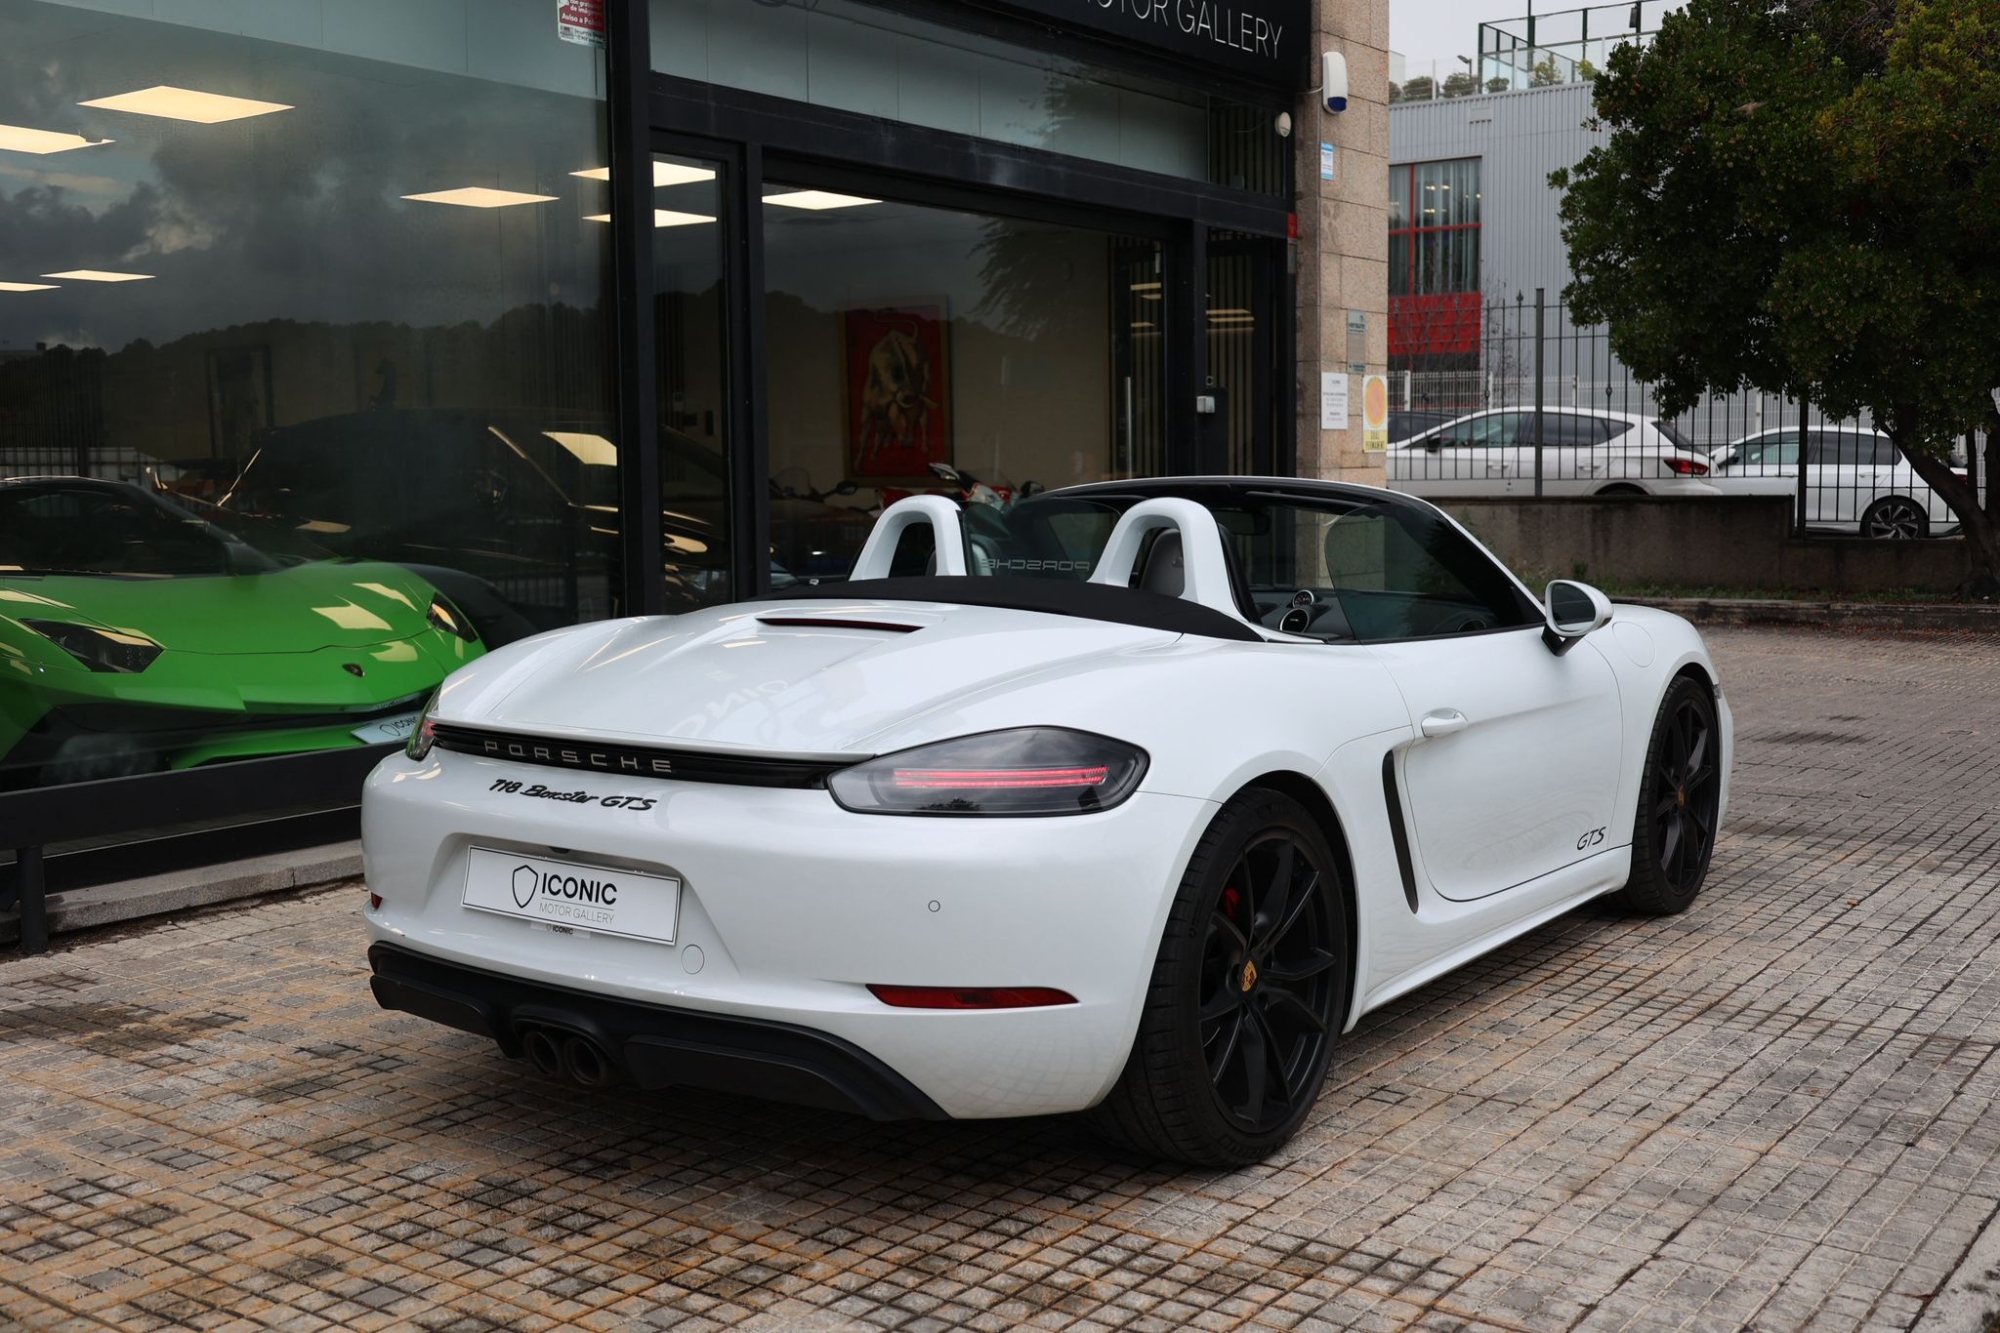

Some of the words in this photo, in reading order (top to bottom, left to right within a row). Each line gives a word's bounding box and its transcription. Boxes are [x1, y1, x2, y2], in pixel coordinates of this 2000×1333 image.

[562, 13, 578, 22] Aviso
[1176, 0, 1283, 60] GALLERY
[484, 740, 673, 773] PORSCHE
[489, 778, 523, 793] 718
[520, 785, 599, 803] Boxster
[600, 796, 657, 811] GTS
[1577, 826, 1606, 850] GTS
[541, 872, 618, 905] ICONIC
[539, 902, 572, 918] MOTOR
[573, 908, 615, 925] GALLERY
